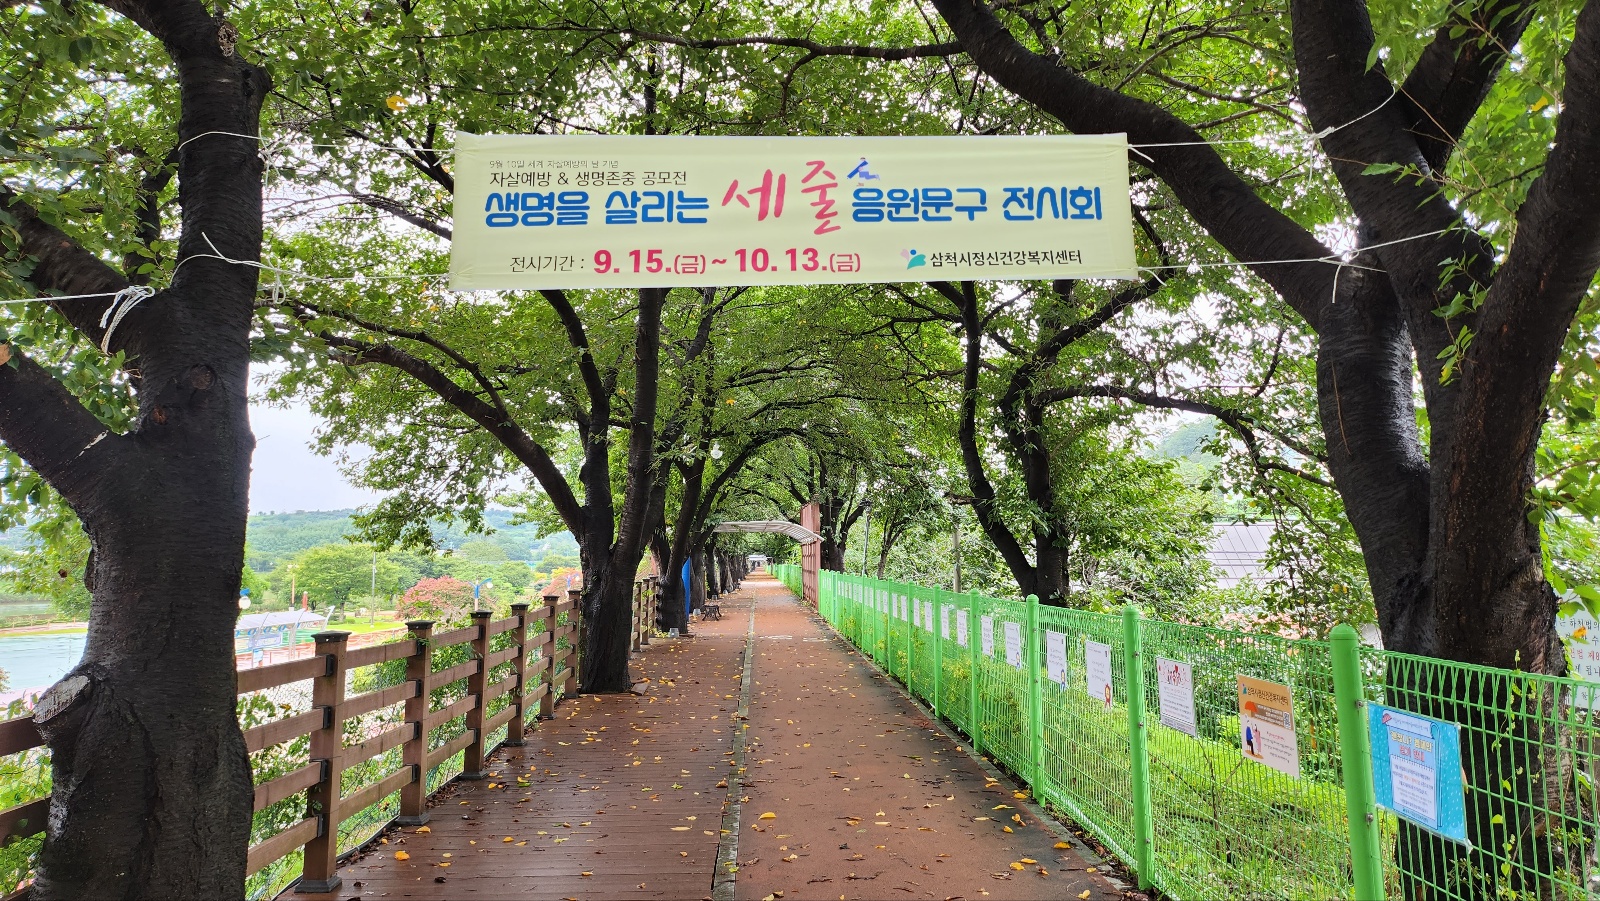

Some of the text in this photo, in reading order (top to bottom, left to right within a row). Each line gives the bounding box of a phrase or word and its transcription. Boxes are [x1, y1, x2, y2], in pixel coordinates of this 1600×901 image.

[489, 160, 619, 169] 9월 10일 세계 자살예방의 날 기념
[489, 170, 687, 187] 자살예방 & 생명존중 공모전
[485, 160, 1103, 235] 생명을 살리는 세 줄 응원문구 전시회
[509, 255, 574, 273] 전시기간
[930, 250, 1082, 268] 삼척시정신건강복지센터
